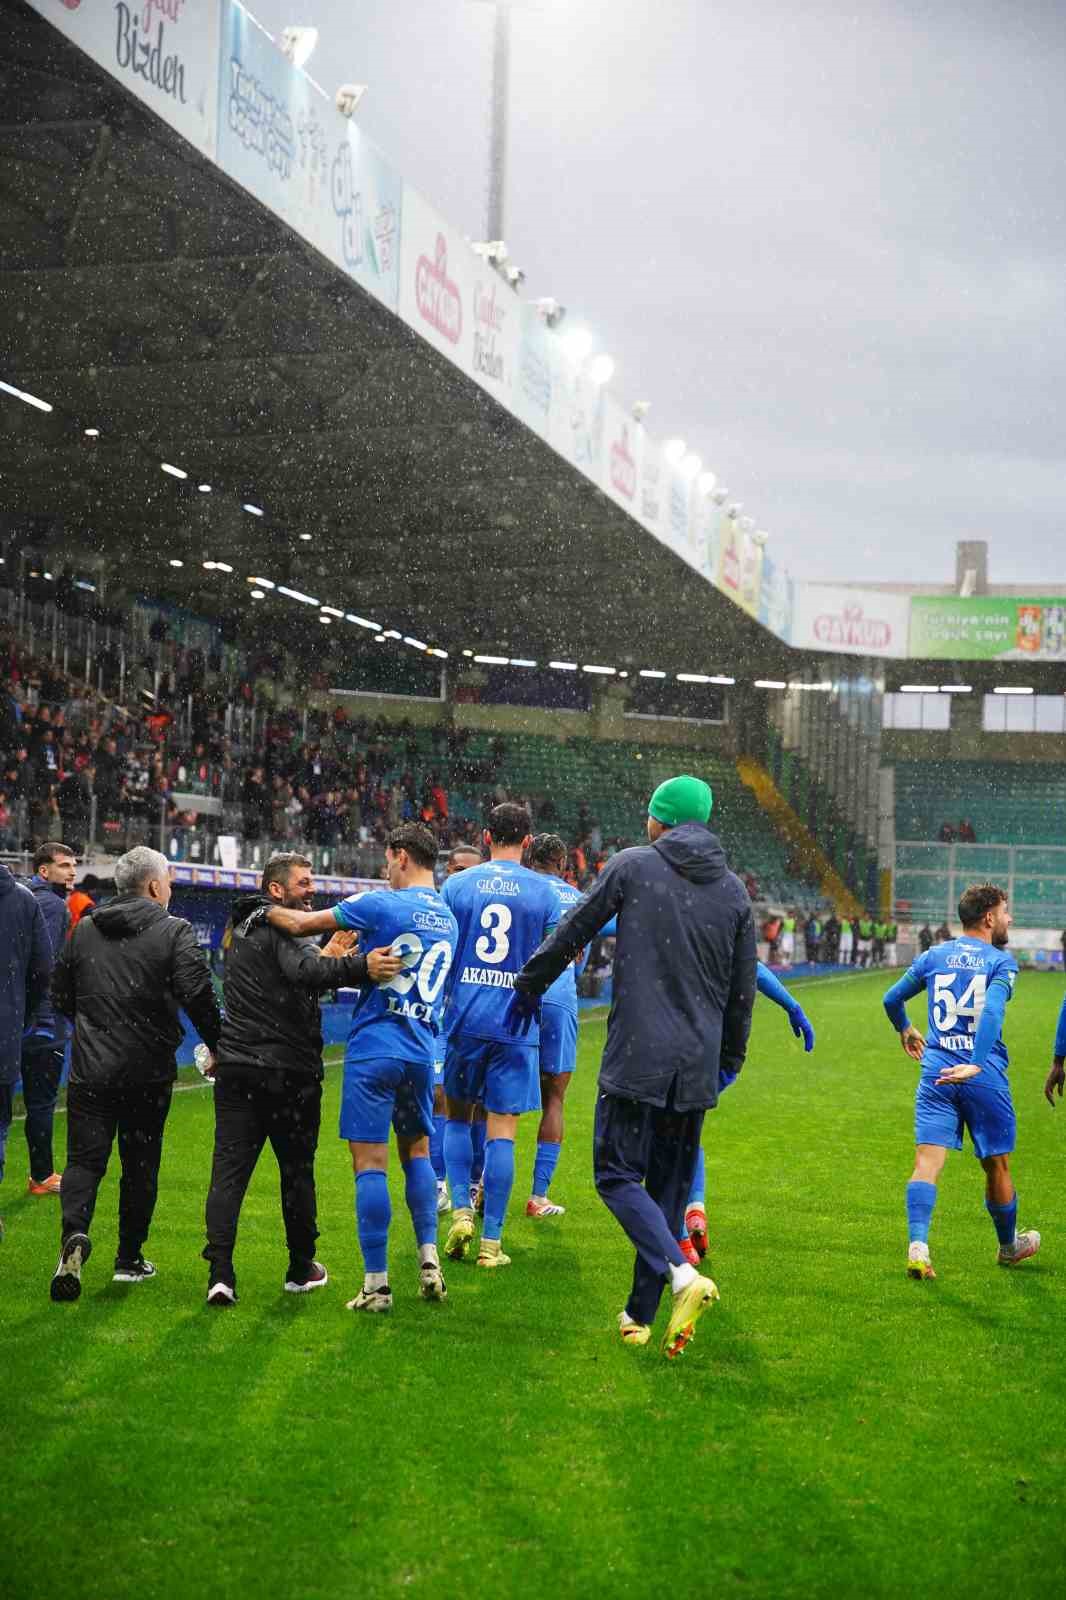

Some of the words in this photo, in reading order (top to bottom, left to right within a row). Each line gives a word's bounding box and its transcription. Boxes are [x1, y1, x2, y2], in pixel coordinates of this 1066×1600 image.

[114, 1, 187, 104] Bizden
[476, 877, 521, 894] GLORIA
[412, 911, 453, 930] GLORIA
[475, 903, 512, 964] 3
[379, 933, 452, 1003] 20
[946, 952, 984, 967] GLORIA
[933, 972, 988, 1033] 54
[939, 1034, 975, 1050] MITH
